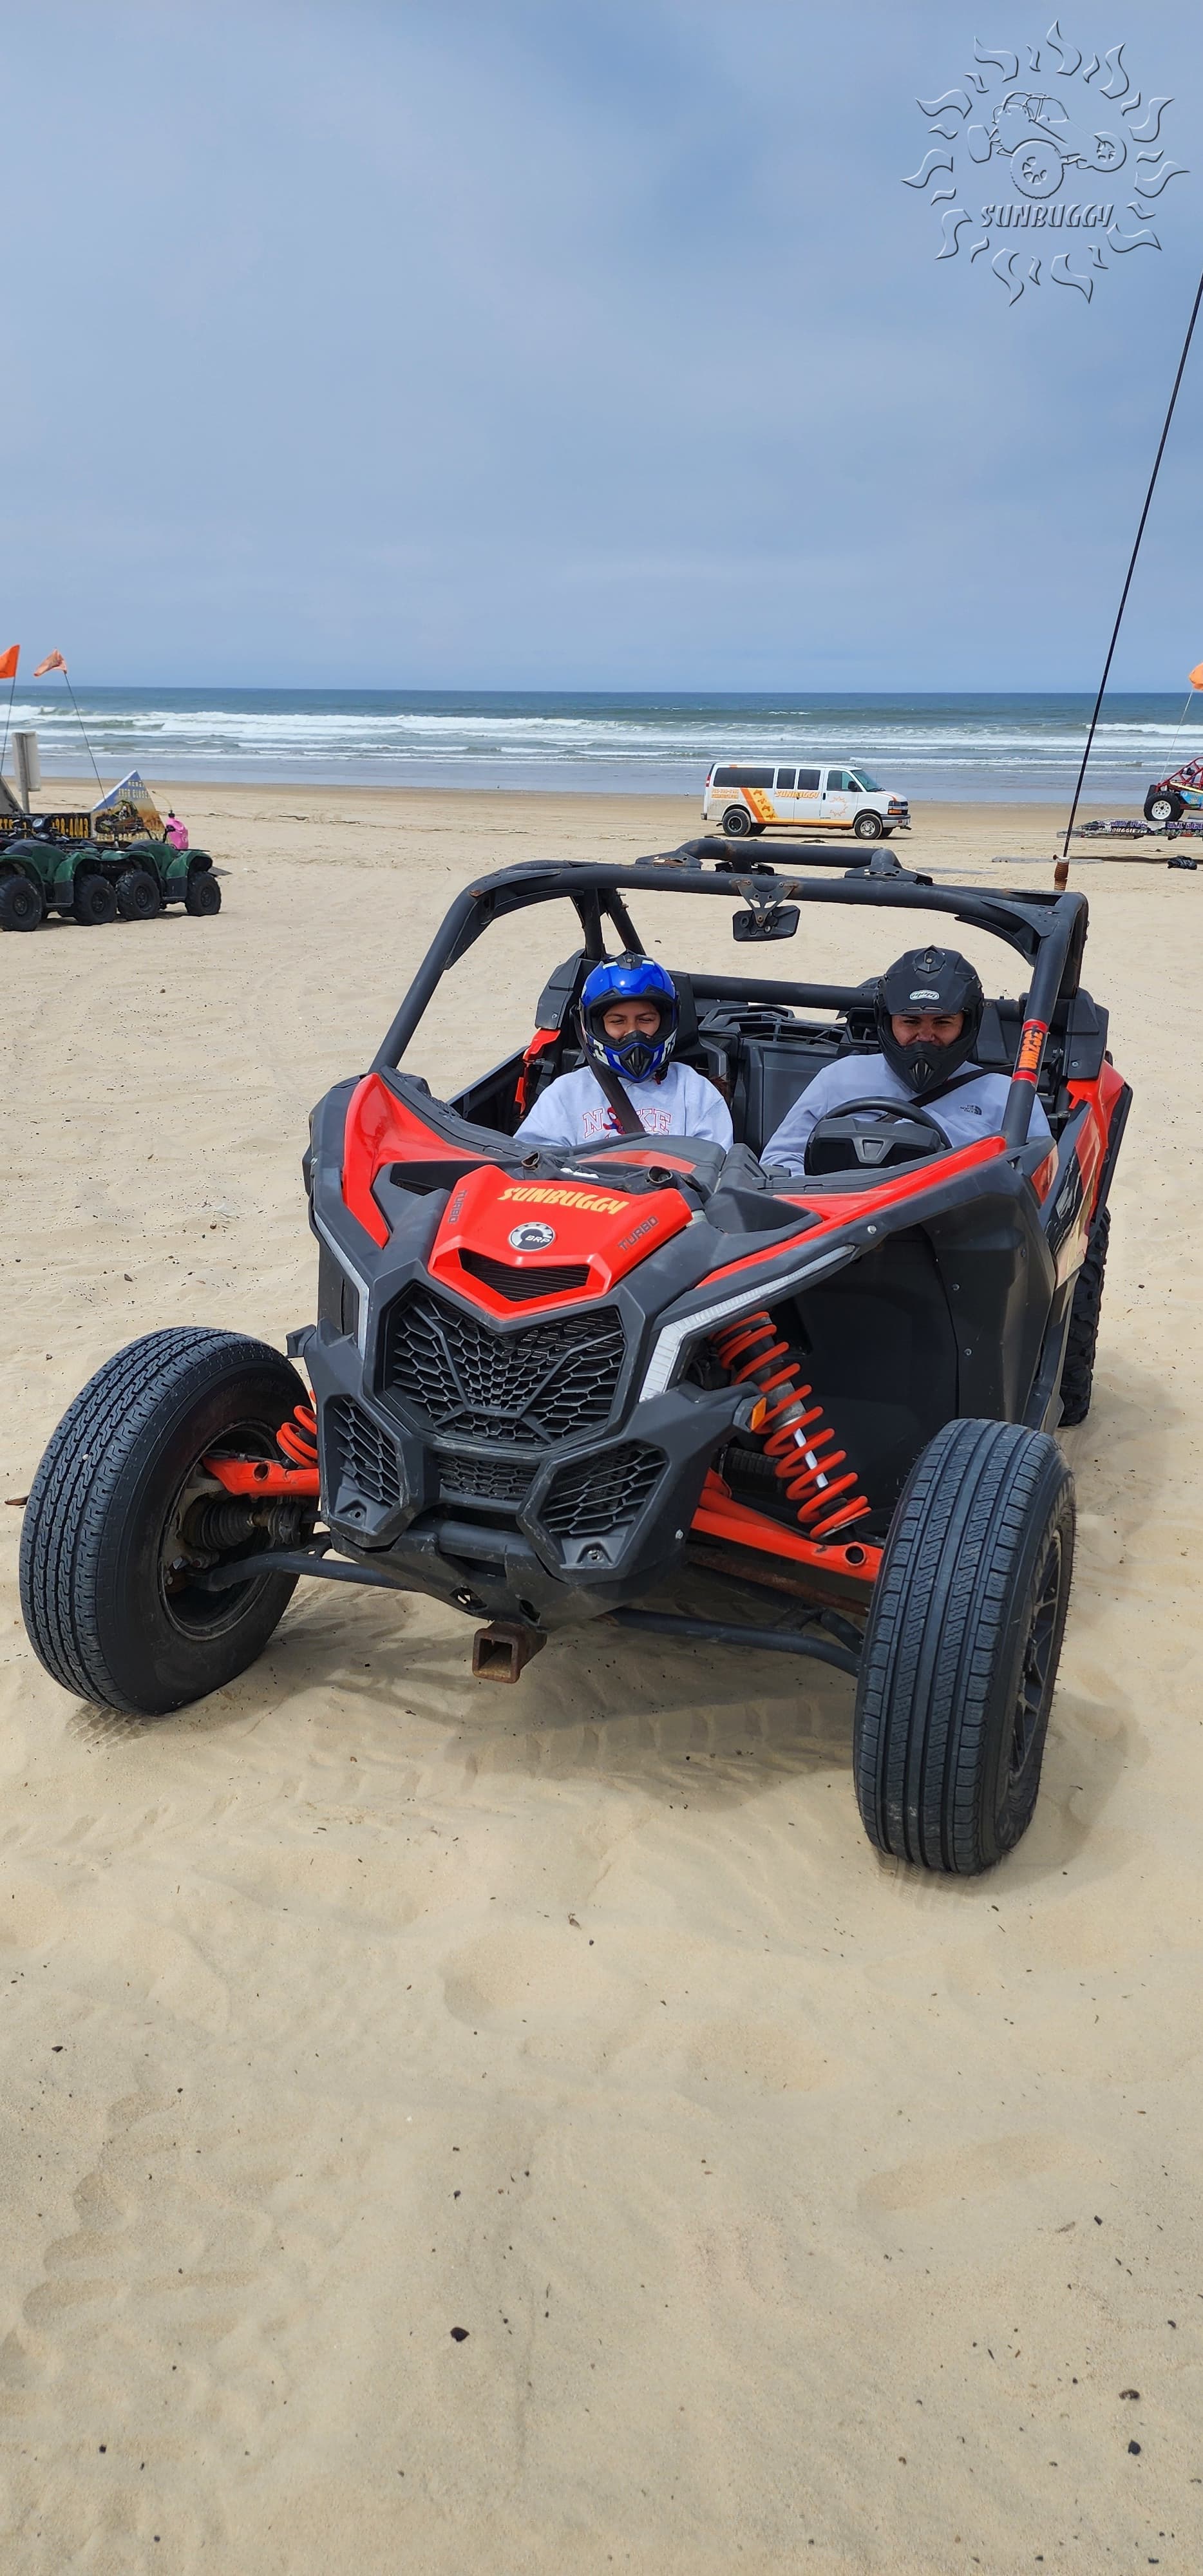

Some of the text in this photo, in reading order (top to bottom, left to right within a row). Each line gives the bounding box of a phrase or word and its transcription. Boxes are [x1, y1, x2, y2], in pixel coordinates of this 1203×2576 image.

[582, 1107, 672, 1139] NKE
[449, 1189, 467, 1224] TURBO
[497, 1187, 630, 1215] SUNBUGGY
[525, 1235, 551, 1243] BRP
[618, 1216, 659, 1251] TURBO
